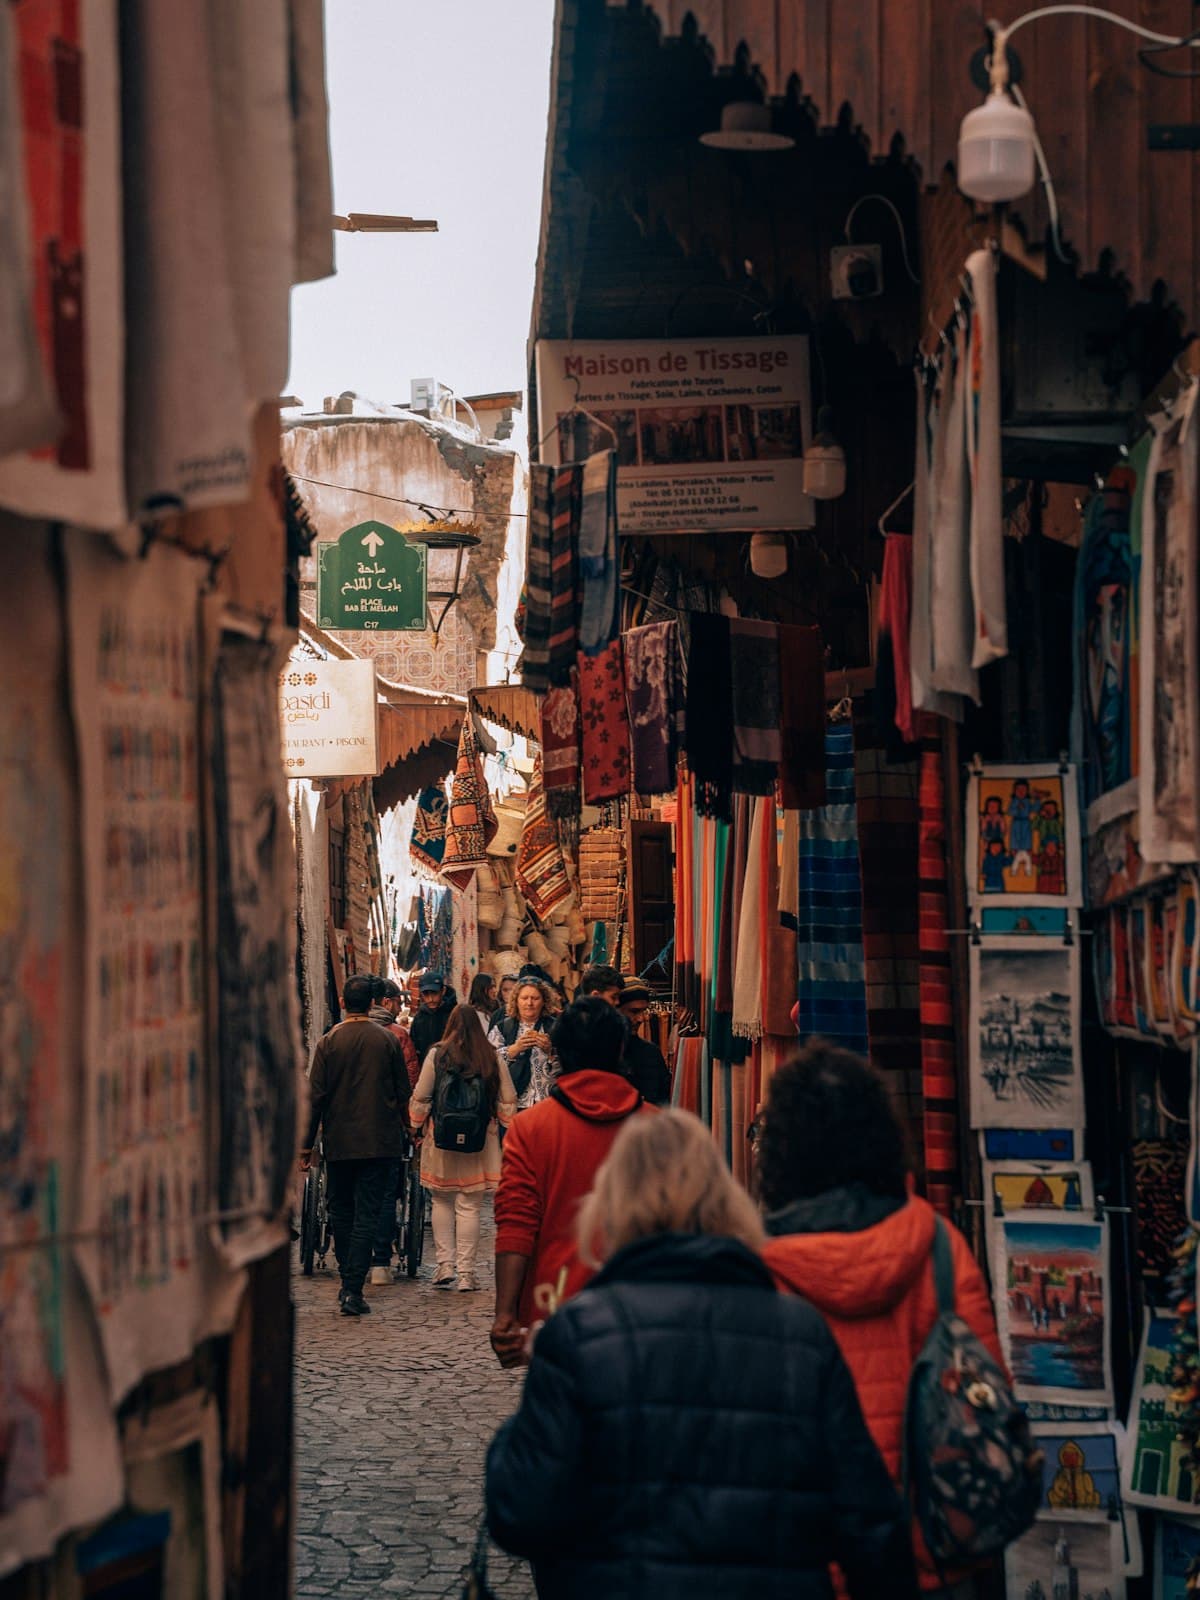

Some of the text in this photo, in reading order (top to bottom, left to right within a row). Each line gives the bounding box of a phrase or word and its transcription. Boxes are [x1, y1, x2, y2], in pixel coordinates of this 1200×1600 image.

[564, 348, 789, 376] Maison de Tissage
[630, 377, 724, 389] Fabrication de Toutes
[604, 392, 615, 401] de
[357, 562, 386, 575] ساحة
[341, 577, 402, 595] باب الملاح
[360, 598, 382, 606] PLACE
[364, 621, 379, 629] C17
[335, 736, 368, 747] PISCINE
